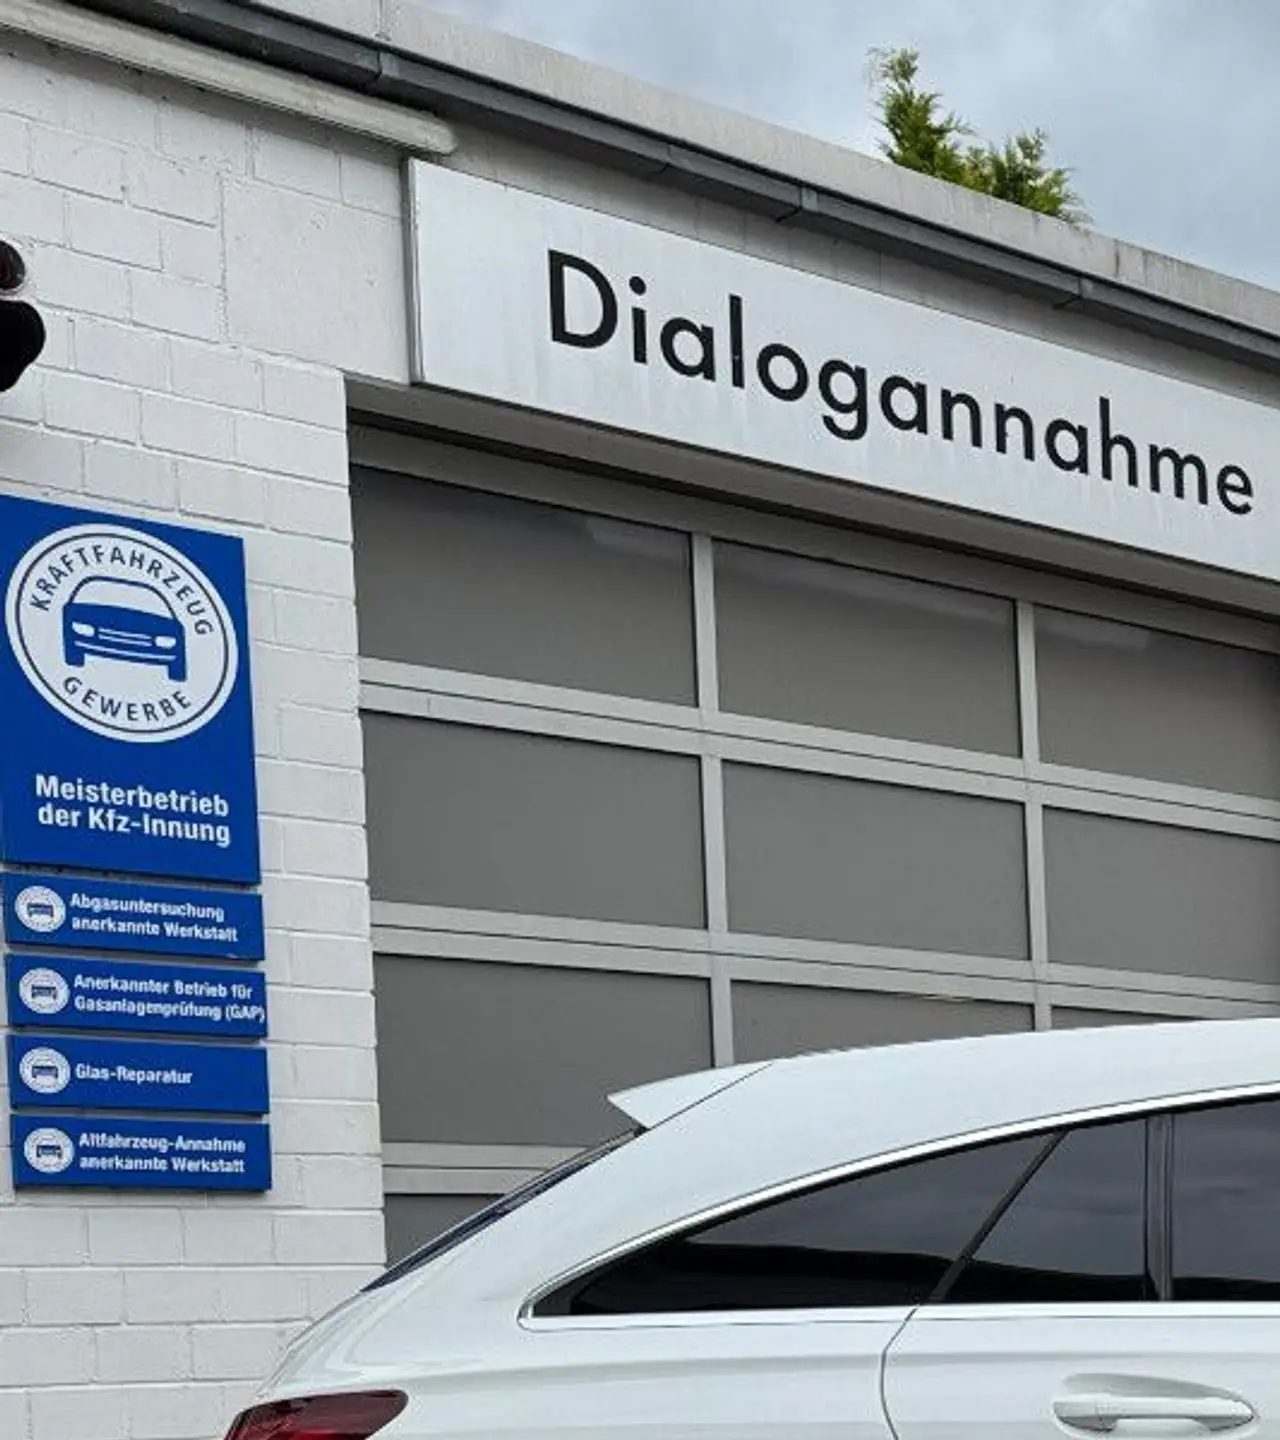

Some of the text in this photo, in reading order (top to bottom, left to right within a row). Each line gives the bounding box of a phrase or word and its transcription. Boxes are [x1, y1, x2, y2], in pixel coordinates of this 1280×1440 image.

[547, 249, 1256, 516] Dialogannahme
[30, 544, 215, 636] KRAFTFAHRZEUG
[63, 676, 191, 722] GEWERBE
[35, 773, 229, 817] Meisterbetrieb
[38, 802, 231, 848] der Kfz-Innung
[70, 893, 225, 922] Abgasuntersuchung
[72, 917, 238, 942] anerkannte Werkstatt
[74, 974, 253, 999] Anerkannter Betrieb für
[74, 996, 221, 1021] Gasanlagenprüfung
[75, 1063, 193, 1085] Glas-Reparatur
[79, 1133, 246, 1153] Altfahrzeug-Annahme
[79, 1155, 245, 1173] anerkannte Werkstatt
